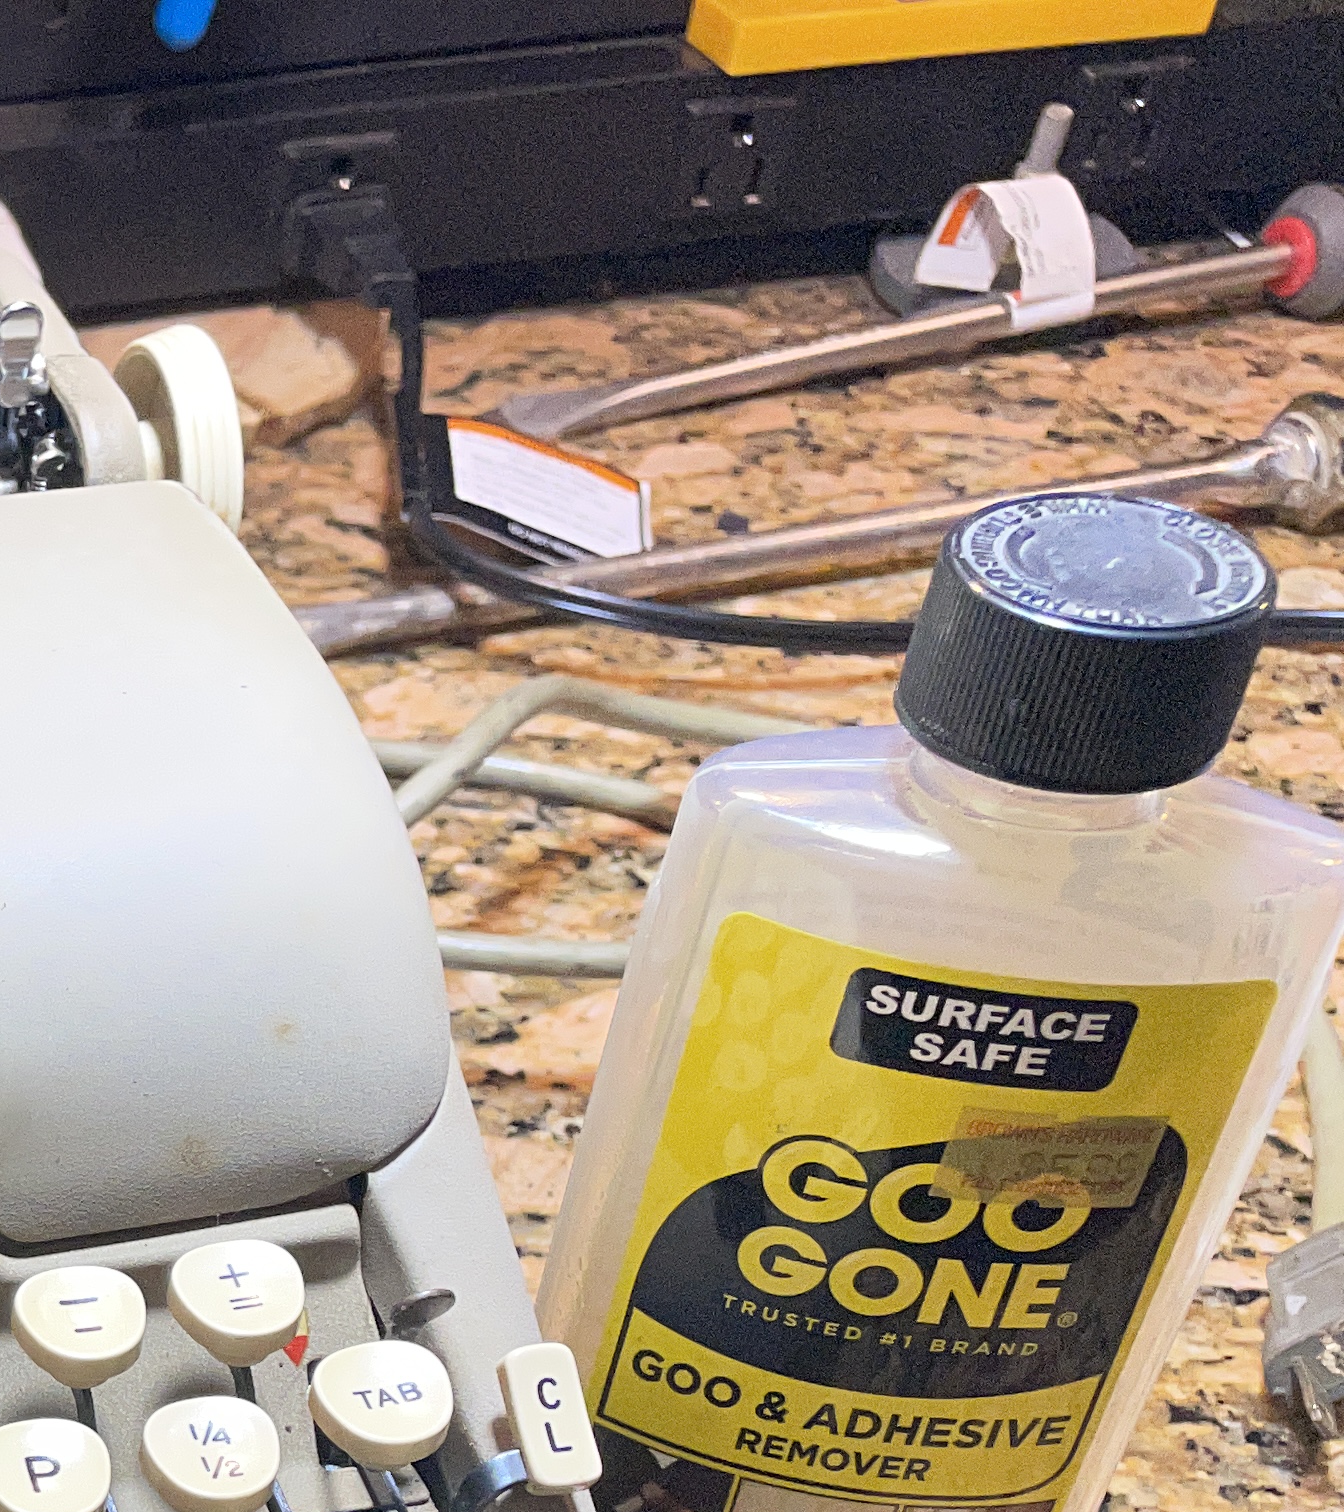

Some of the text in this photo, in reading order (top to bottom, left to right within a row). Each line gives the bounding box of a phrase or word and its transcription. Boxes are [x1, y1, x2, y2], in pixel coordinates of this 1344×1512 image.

[865, 984, 1111, 1043] SURFACE
[909, 1032, 1052, 1077] SAFE
[762, 1138, 1092, 1252] GOO
[722, 1294, 1039, 1357] TRUSTED #1 BRAND
[352, 1382, 423, 1410] TAB
[631, 1349, 1073, 1449] GOO & ADHESIVE
[24, 1455, 61, 1494] P
[735, 1427, 932, 1482] REMOVER
